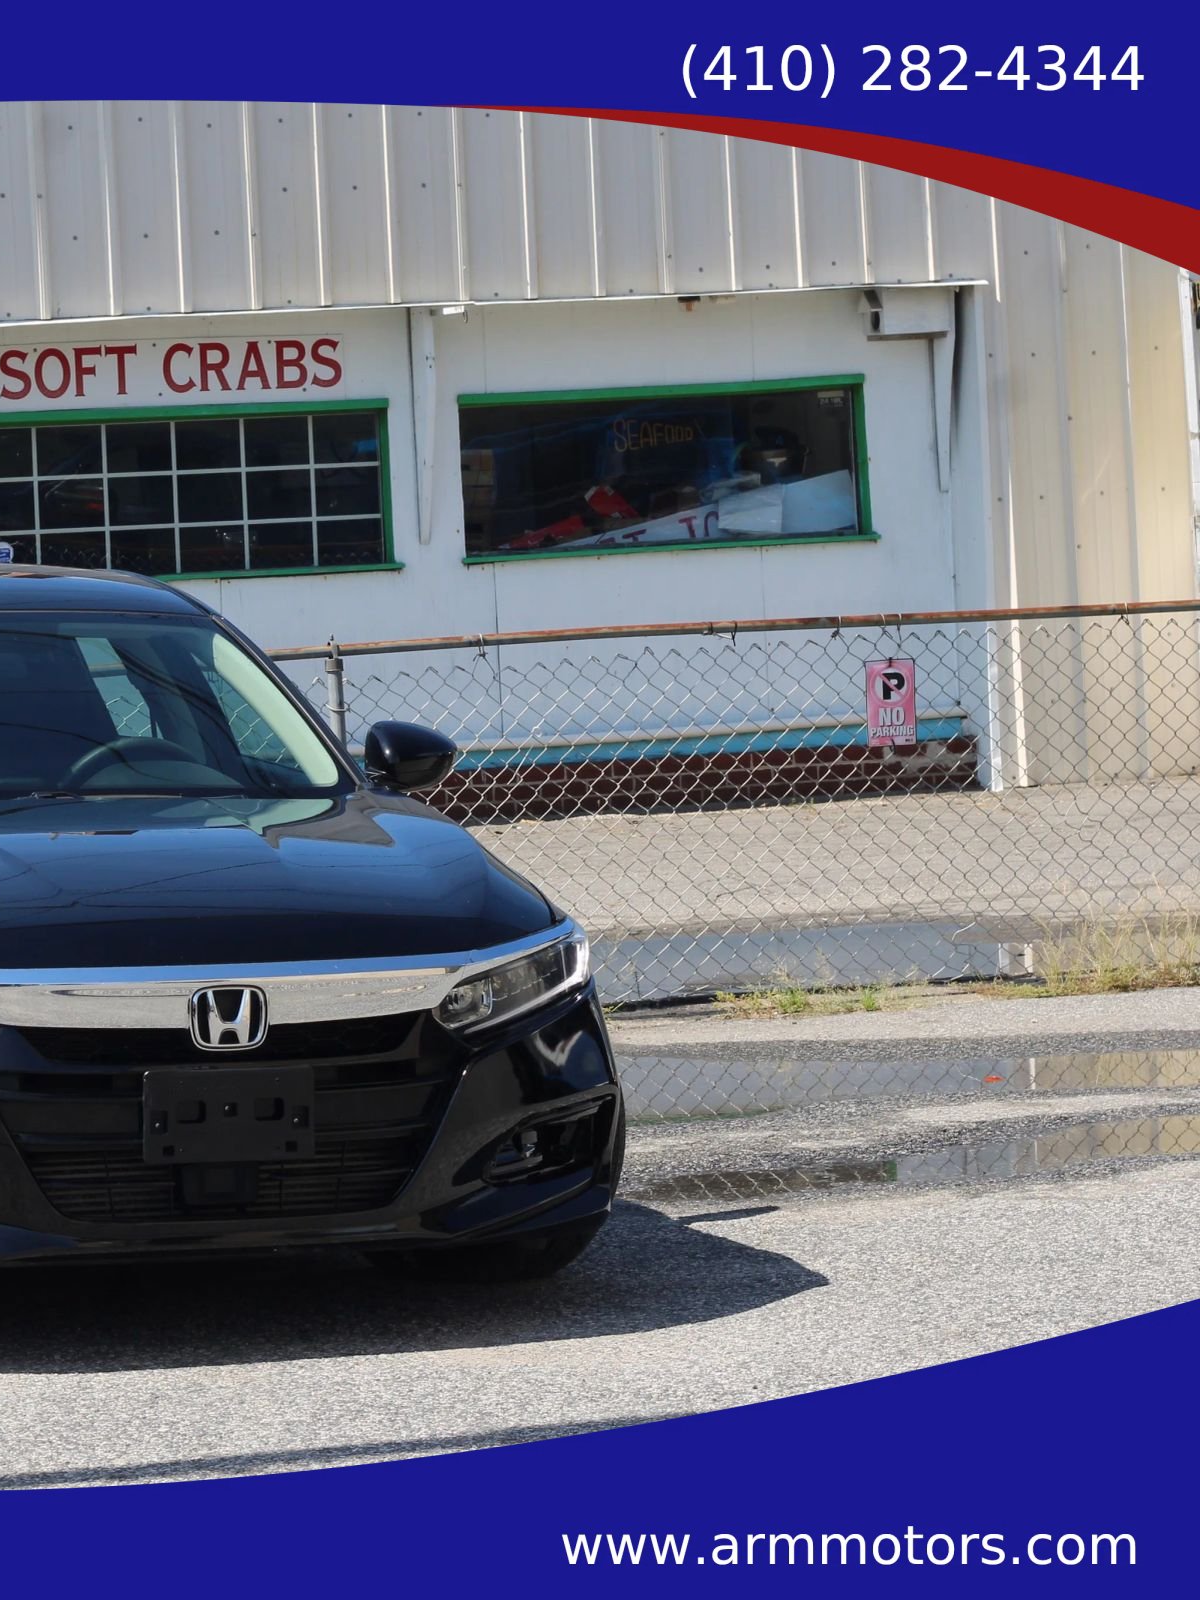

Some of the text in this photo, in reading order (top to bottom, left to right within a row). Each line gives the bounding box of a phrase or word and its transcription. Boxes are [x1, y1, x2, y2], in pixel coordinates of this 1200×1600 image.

[0, 338, 343, 400] SOFT CRABS
[613, 418, 694, 452] SEAFOOD
[878, 706, 905, 726] NO
[870, 725, 914, 738] PARKING
